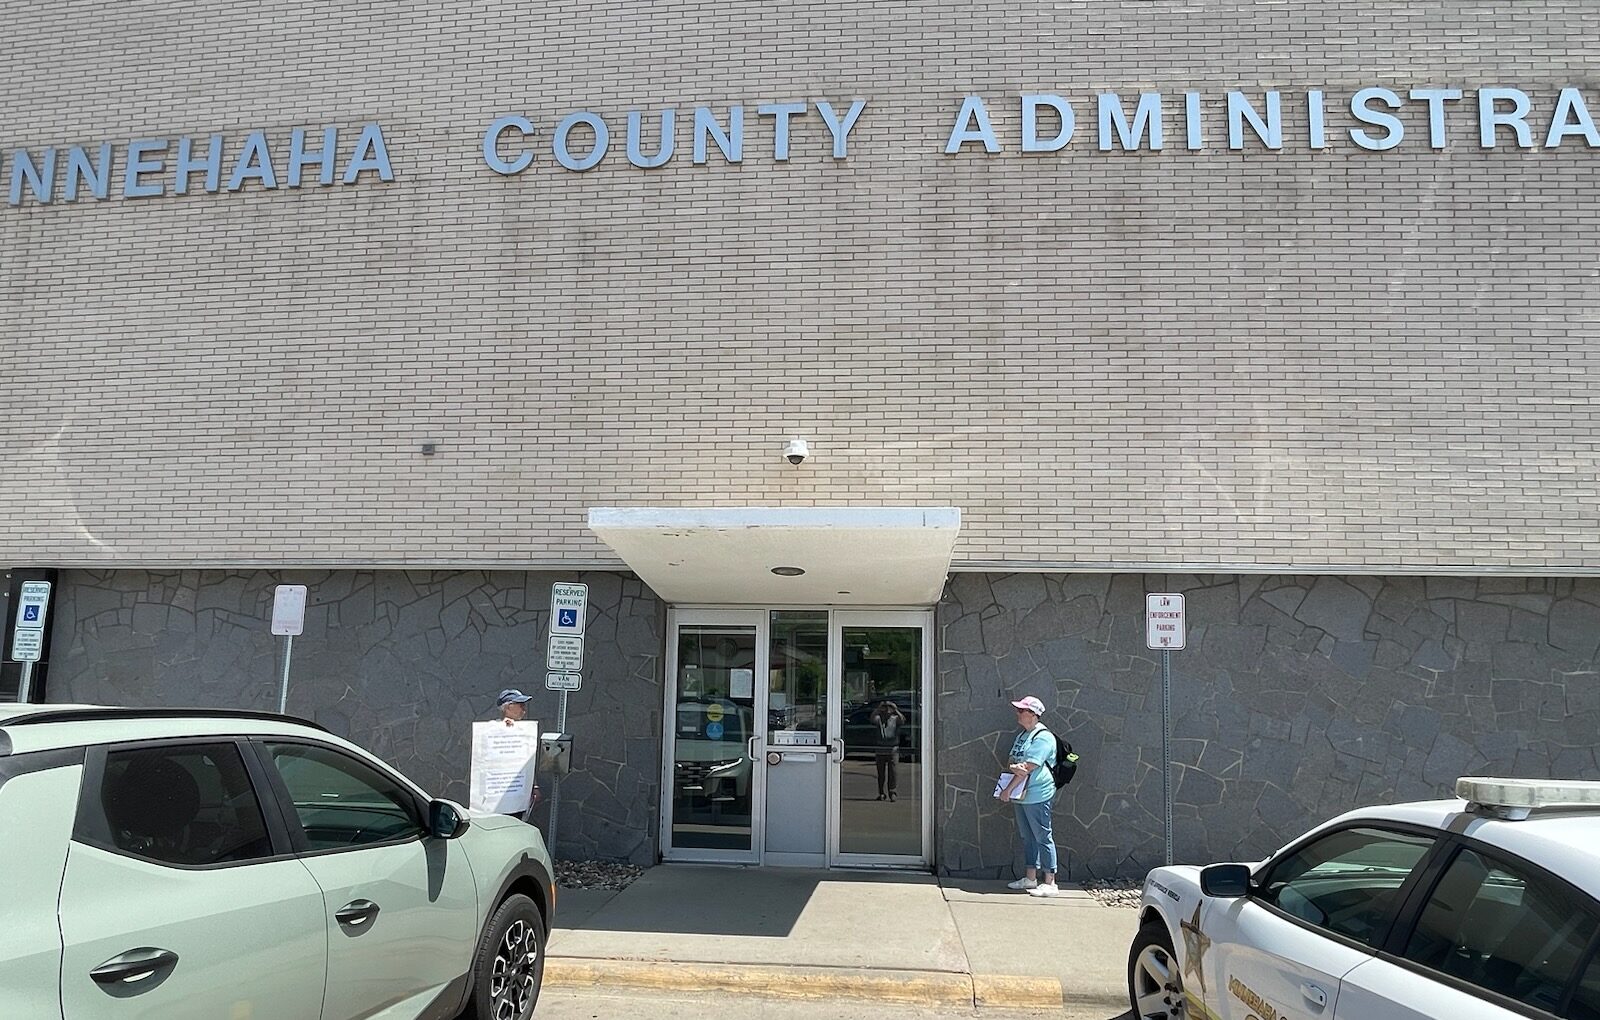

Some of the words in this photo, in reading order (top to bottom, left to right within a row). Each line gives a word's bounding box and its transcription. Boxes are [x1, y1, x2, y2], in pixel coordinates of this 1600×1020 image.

[482, 99, 867, 176] COUNTY
[944, 85, 1600, 155] ADMINISTRA
[555, 588, 584, 597] RESERVED
[556, 599, 582, 607] PARKING
